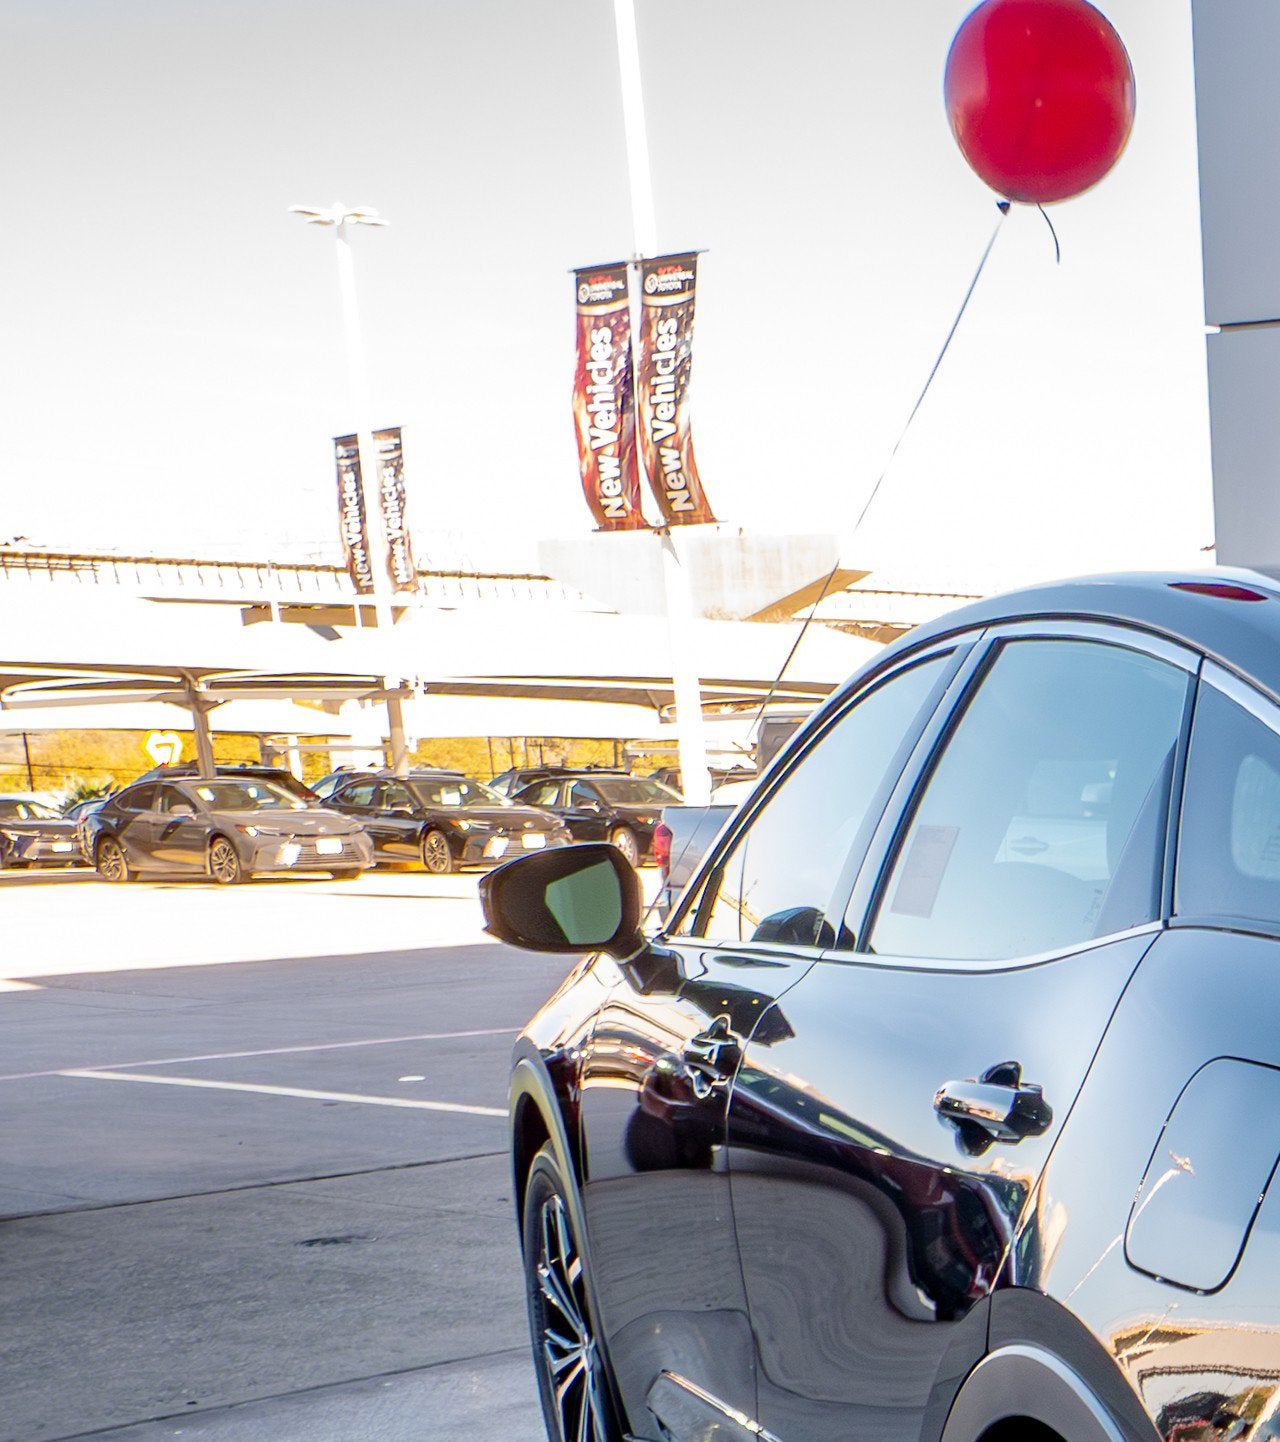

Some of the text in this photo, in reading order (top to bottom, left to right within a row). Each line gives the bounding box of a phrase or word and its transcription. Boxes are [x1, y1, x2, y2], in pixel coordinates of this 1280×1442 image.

[586, 326, 626, 518] New Vehicles
[650, 317, 695, 512] New Vehicles
